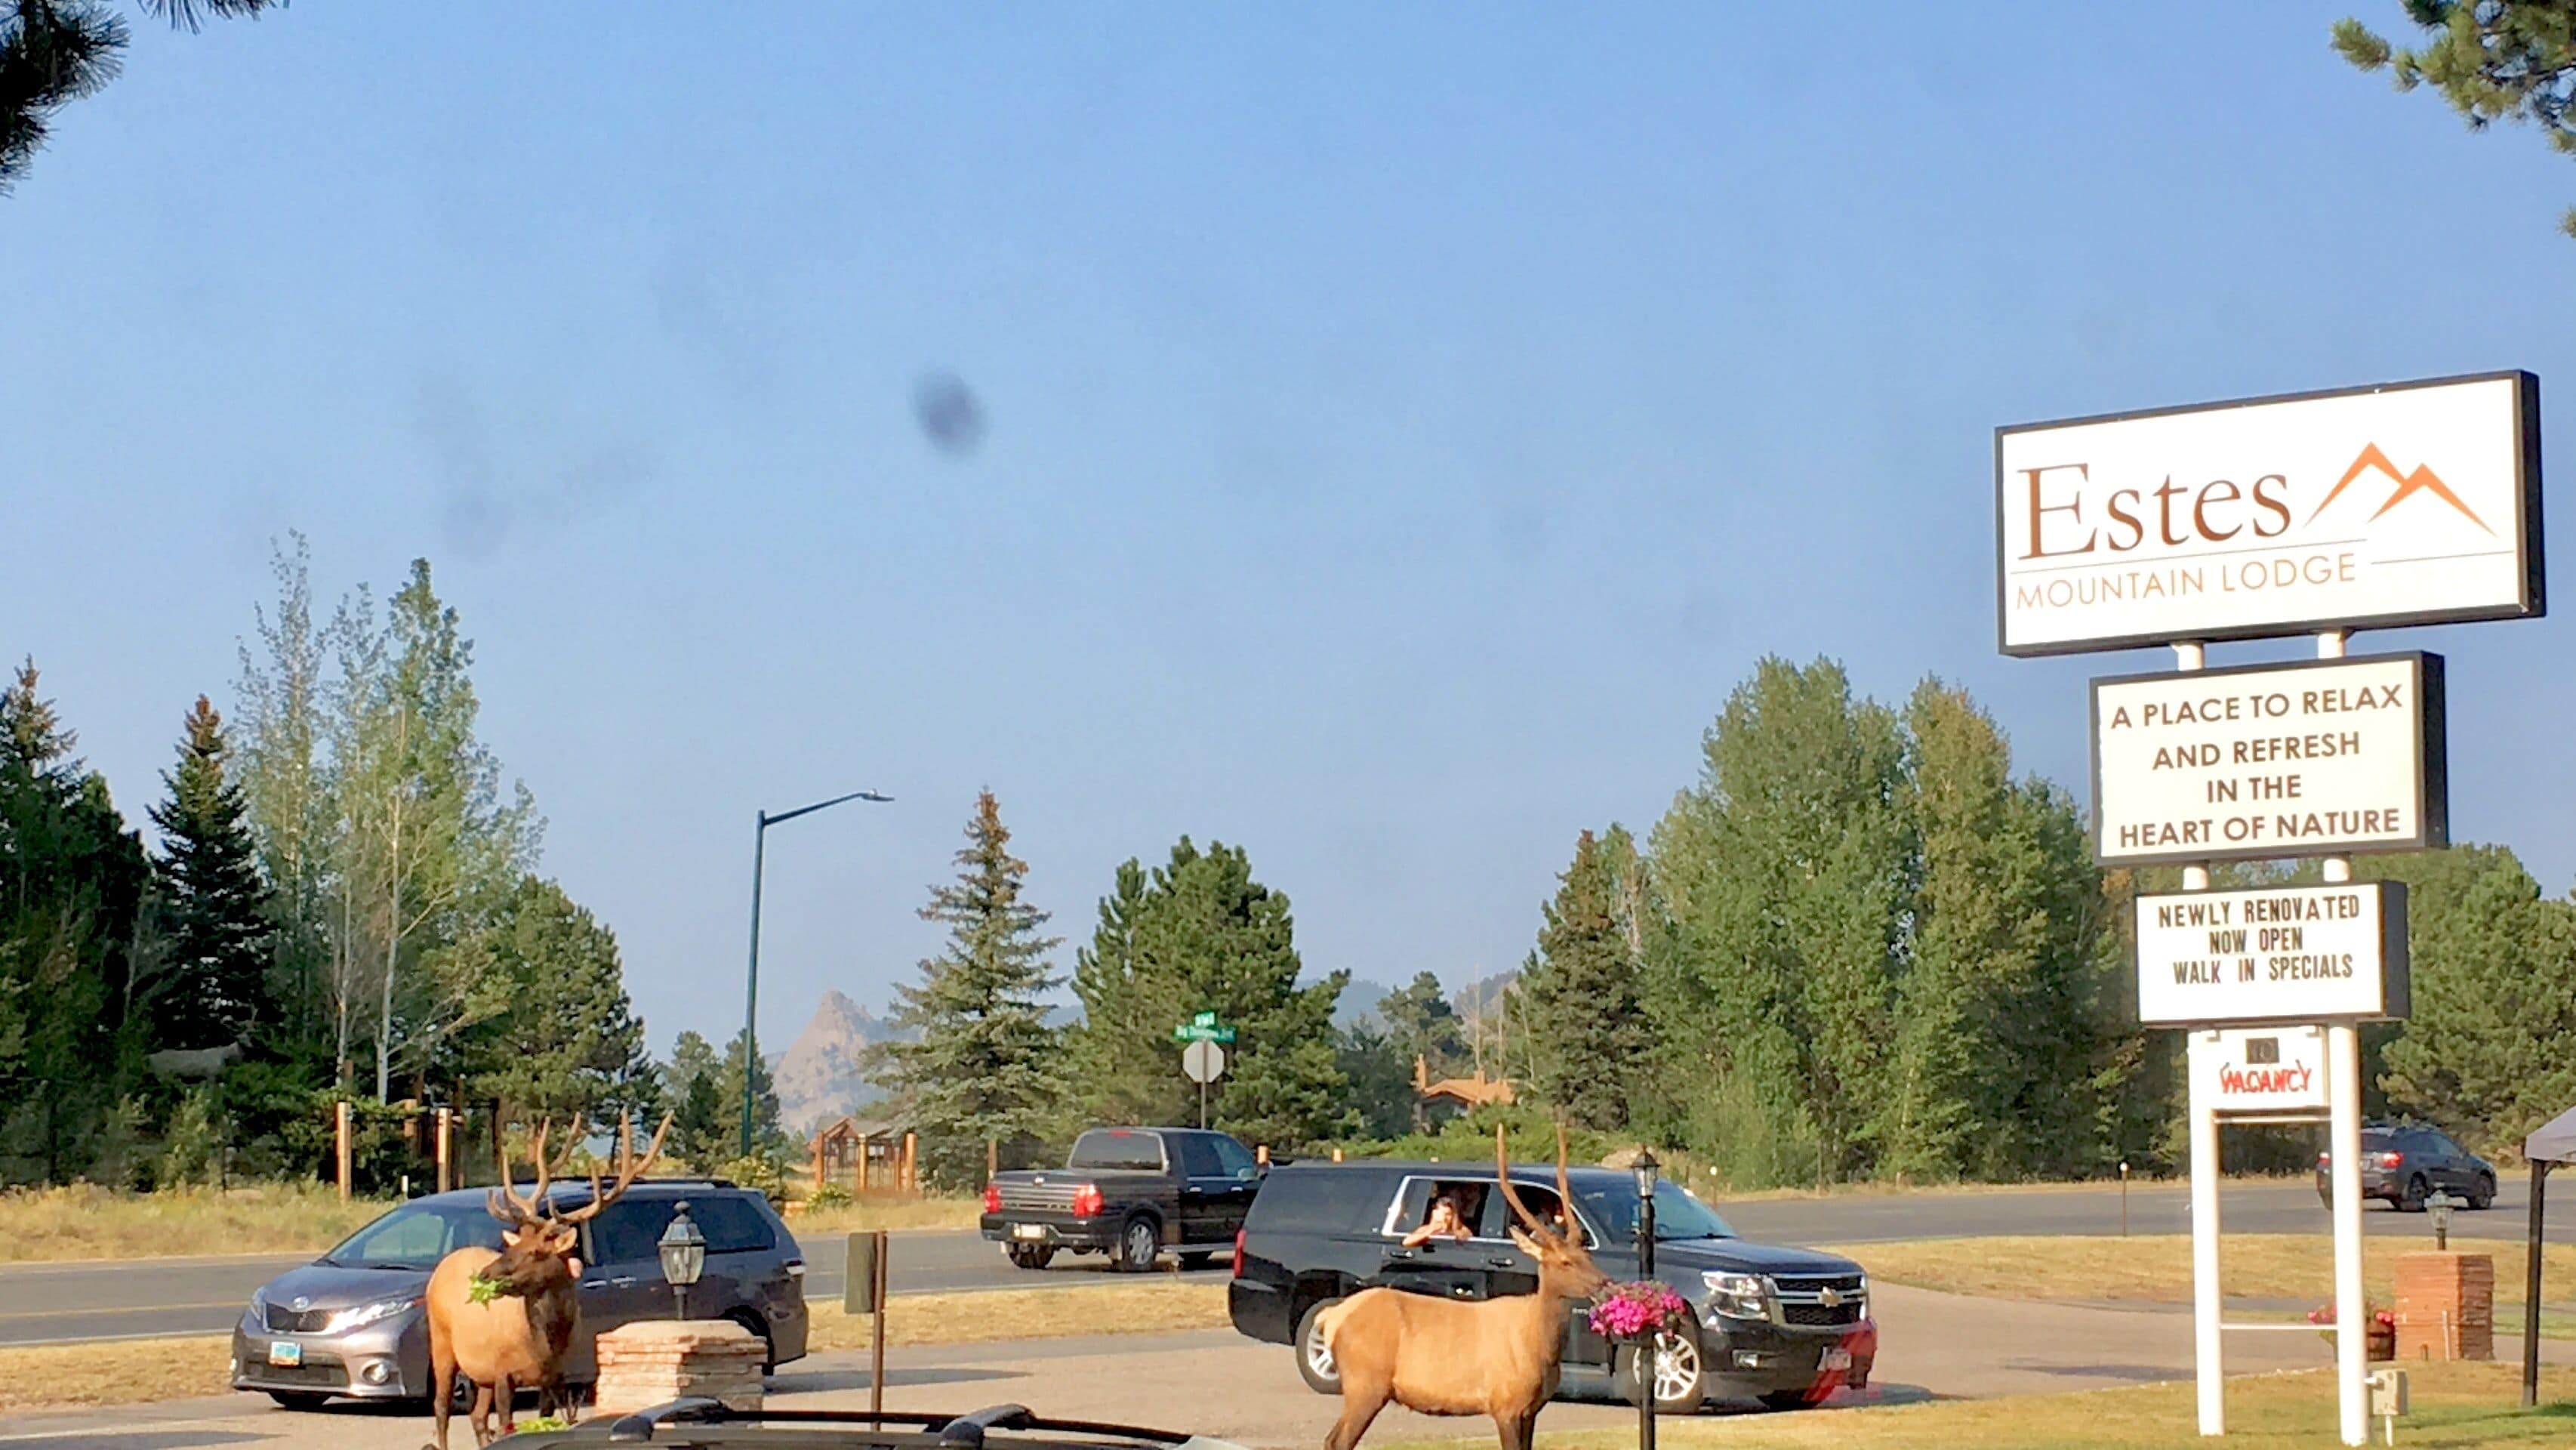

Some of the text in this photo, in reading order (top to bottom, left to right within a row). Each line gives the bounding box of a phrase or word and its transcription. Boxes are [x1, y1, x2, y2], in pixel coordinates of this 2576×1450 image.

[2017, 463, 2291, 560] Estes
[2017, 553, 2356, 610] MOUNTAIN LODGE
[2111, 683, 2402, 729] A PLACE TO RELAX
[2152, 732, 2360, 770] AND REFRESH
[2208, 775, 2301, 803] IN THE
[2120, 808, 2399, 848] HEART OF NATURE
[2158, 895, 2360, 928] NEWLY RENOVATED
[2209, 927, 2303, 954] NOW OPEN
[2174, 954, 2353, 984] WALK IN SPECIALS
[2220, 1061, 2312, 1094] VACANCY
